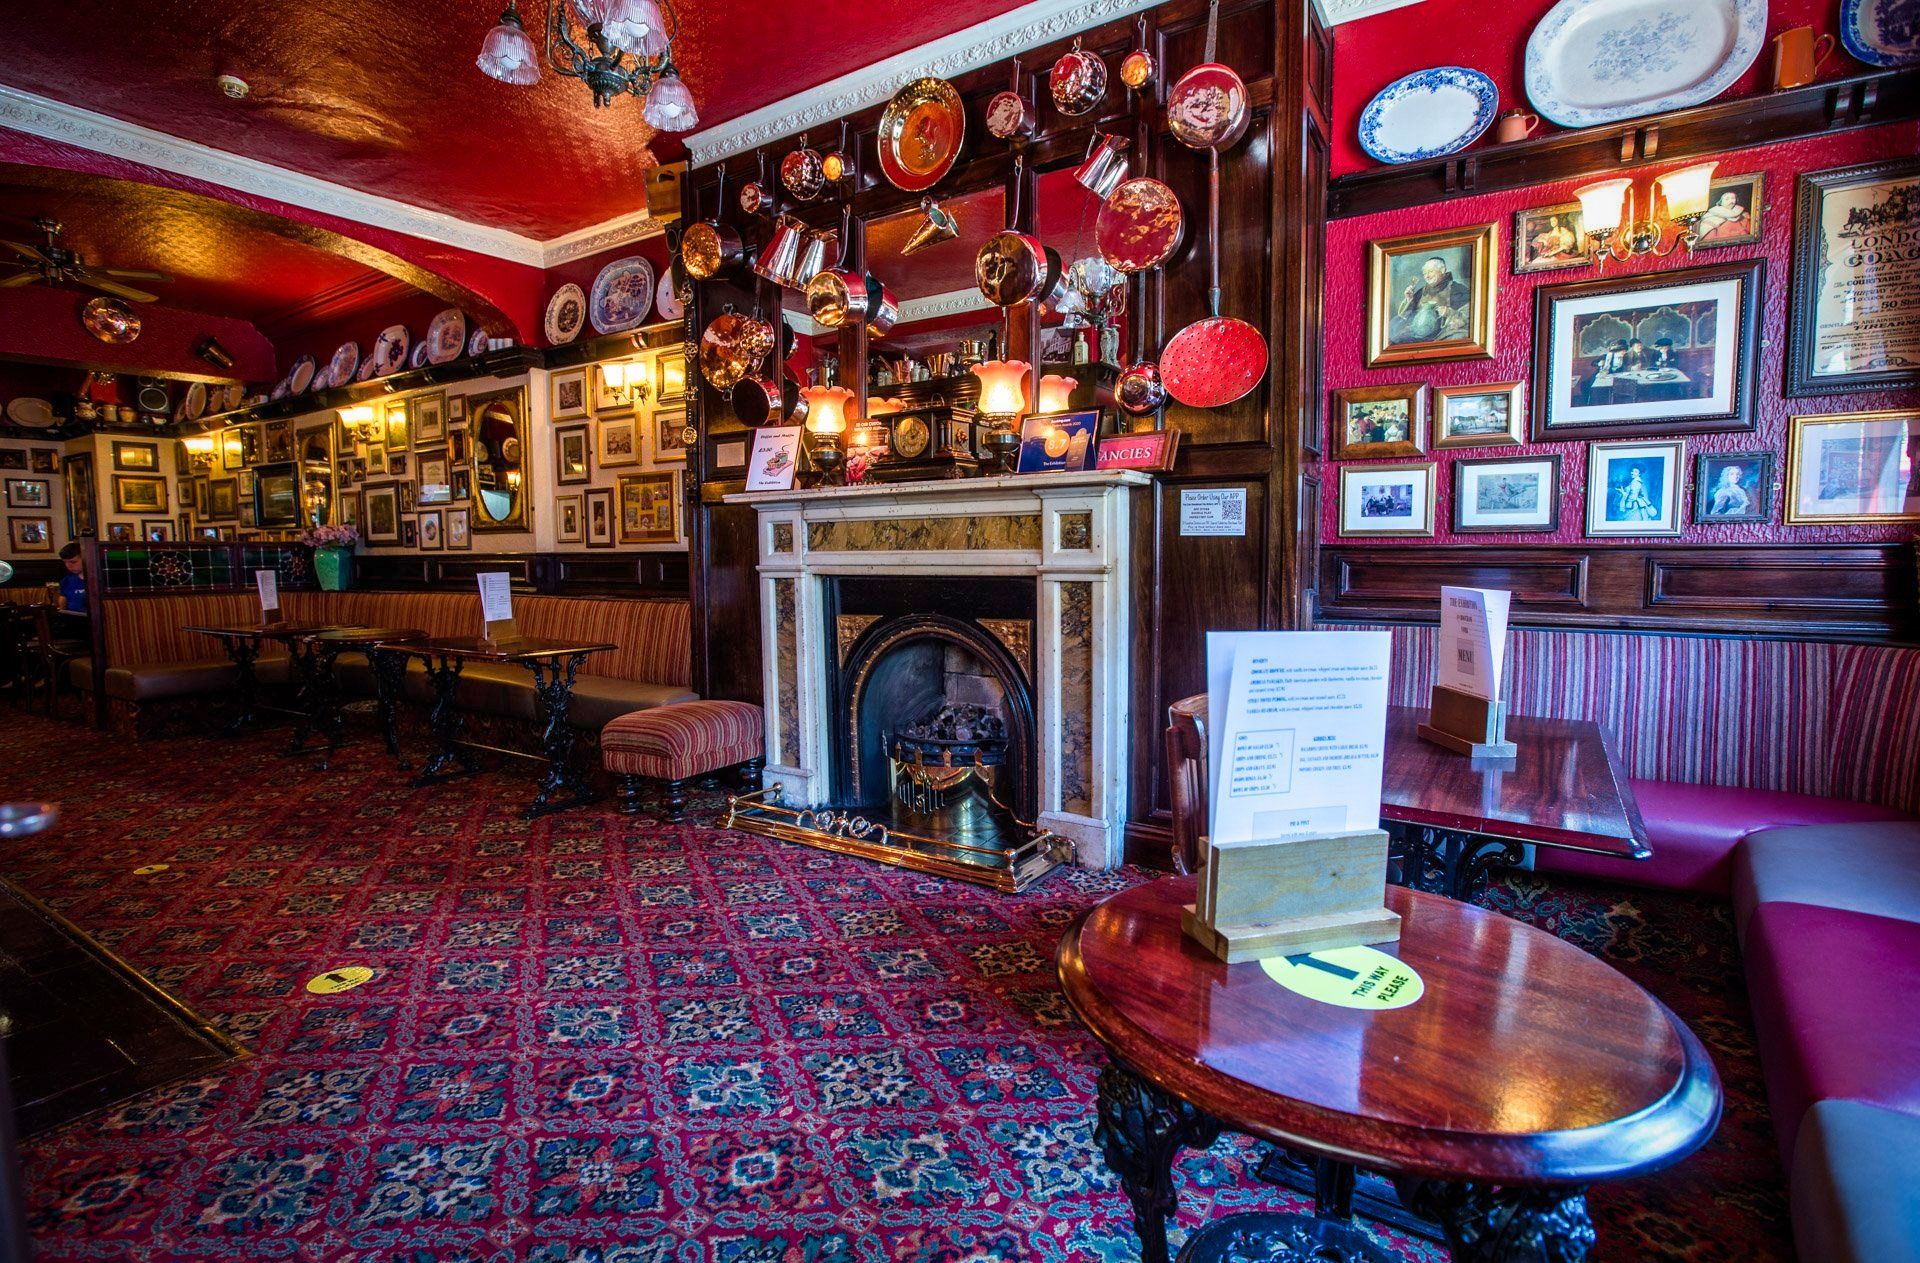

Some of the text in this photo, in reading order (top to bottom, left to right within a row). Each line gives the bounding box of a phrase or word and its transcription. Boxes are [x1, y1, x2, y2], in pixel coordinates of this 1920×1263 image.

[1851, 229, 1920, 249] LONDO
[1844, 247, 1920, 268] COAC
[1881, 300, 1898, 310] 50
[1049, 438, 1067, 450] 8.7
[1097, 447, 1151, 461] ANCIES
[1197, 493, 1209, 501] Order
[1220, 492, 1229, 500] Our
[1229, 492, 1239, 500] APP
[1458, 648, 1473, 664] MENU
[1352, 965, 1389, 997] THIS WAY
[1377, 975, 1409, 1001] PLEASE
